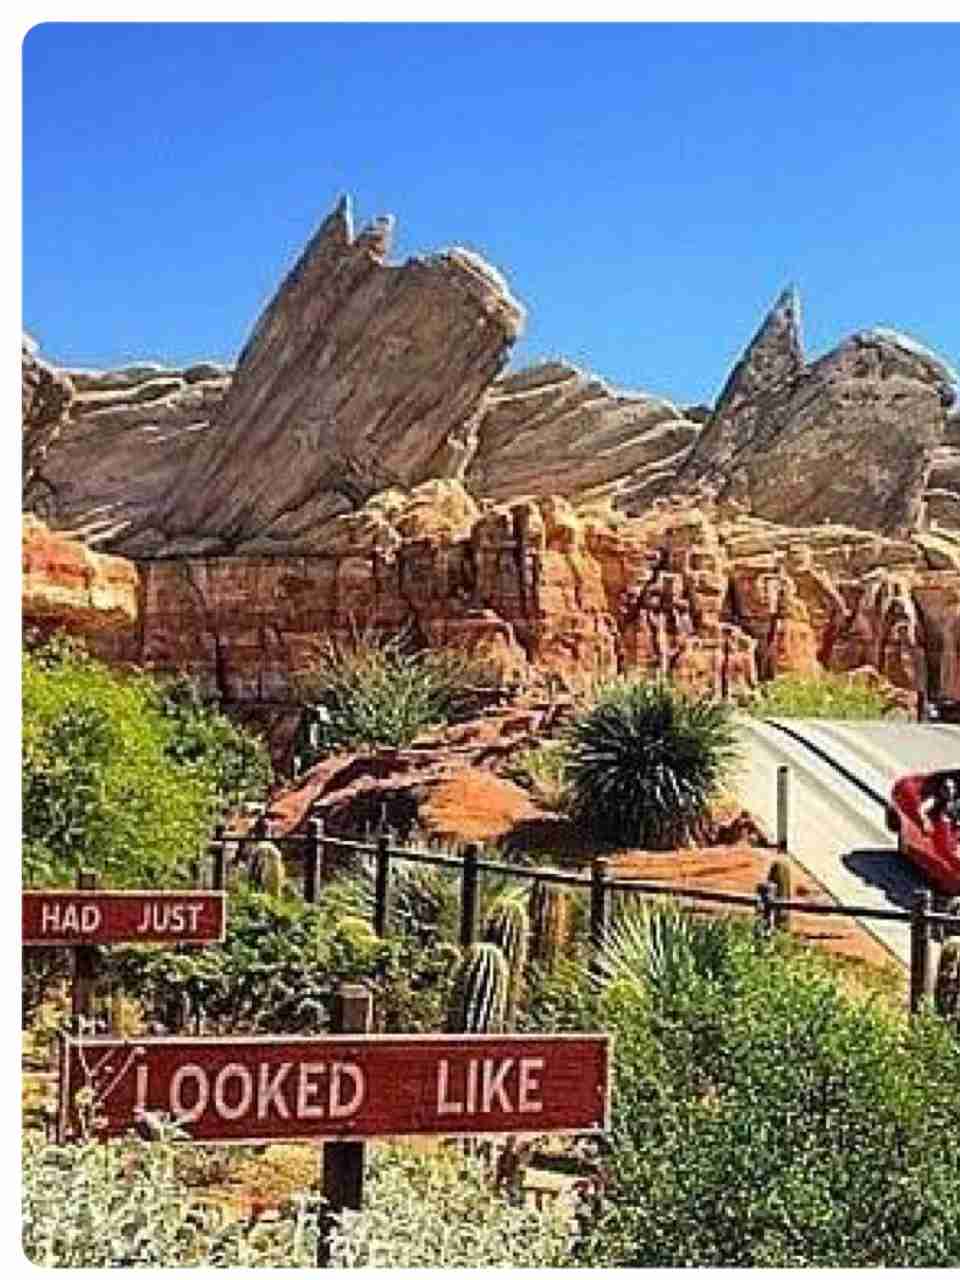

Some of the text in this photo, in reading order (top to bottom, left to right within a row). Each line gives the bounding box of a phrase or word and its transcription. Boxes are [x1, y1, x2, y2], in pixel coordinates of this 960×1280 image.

[41, 903, 204, 933] HAD JUST
[134, 1057, 545, 1121] LOOKED LIKE
